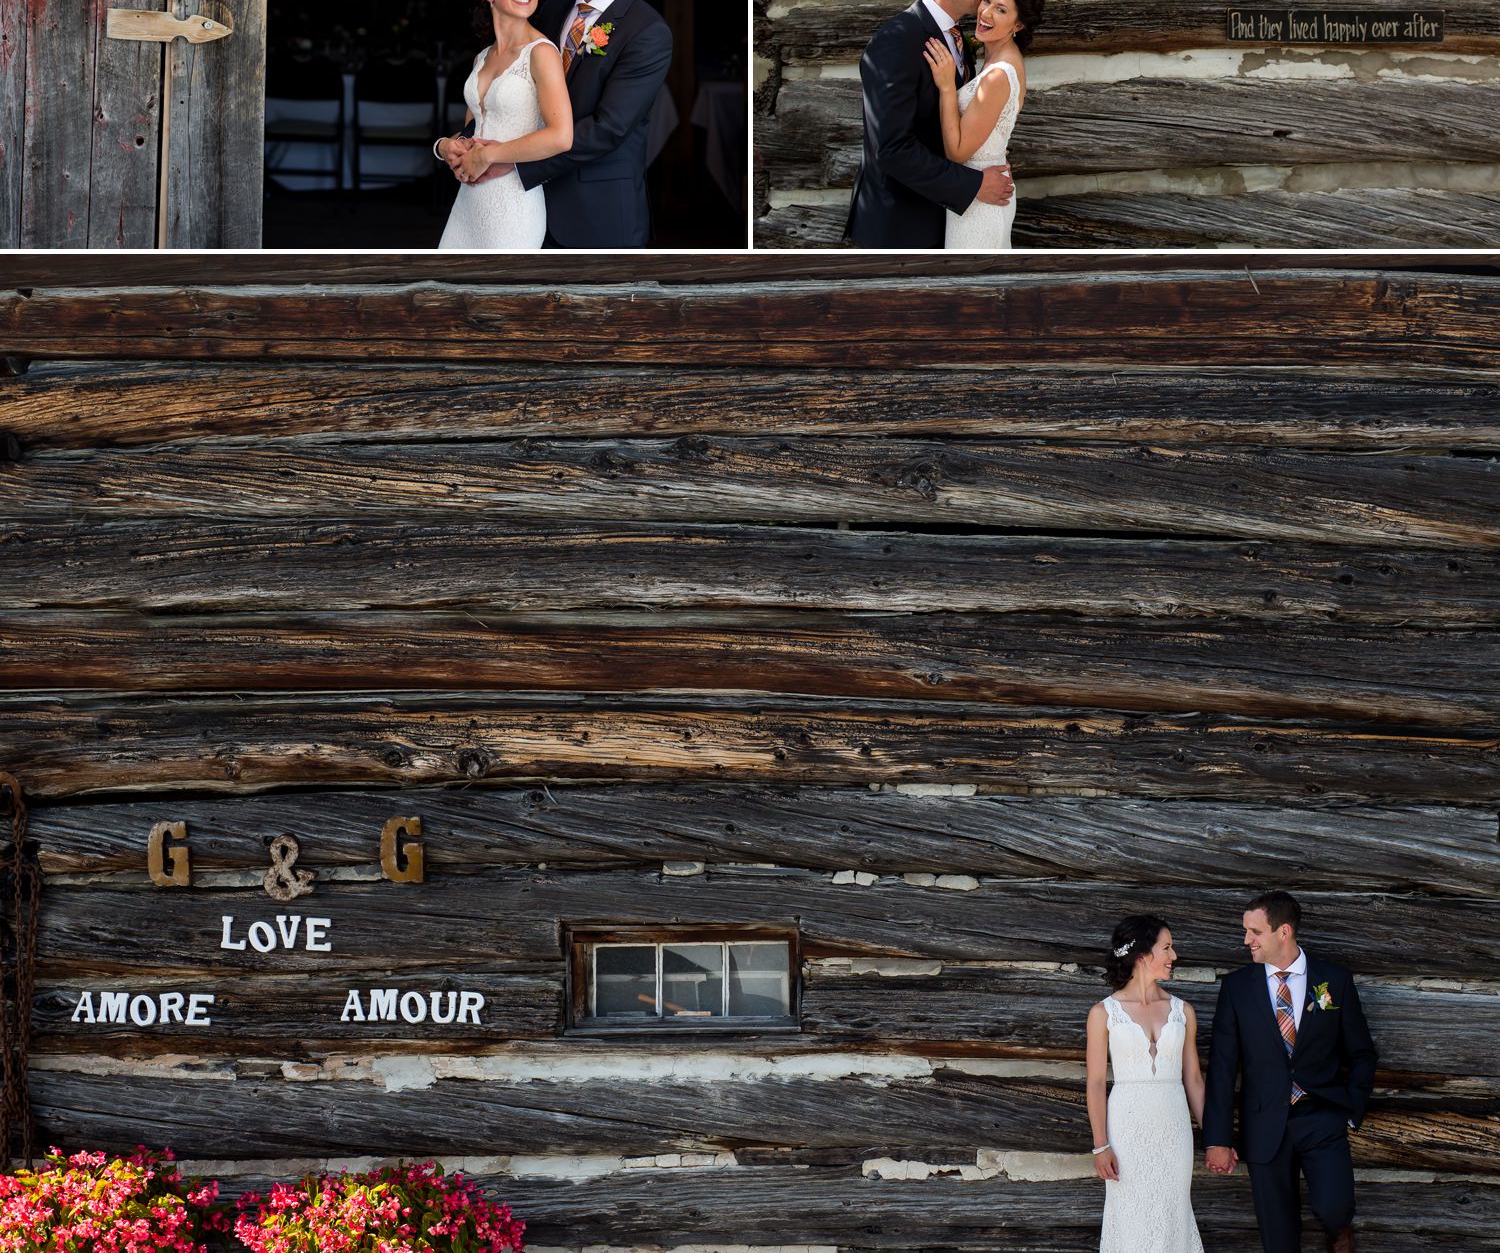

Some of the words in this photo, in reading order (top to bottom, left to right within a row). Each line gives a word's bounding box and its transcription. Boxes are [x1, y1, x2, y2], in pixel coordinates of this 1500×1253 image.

[1231, 12, 1254, 39] And
[1259, 14, 1283, 41] they
[1289, 11, 1318, 39] lived
[1323, 14, 1368, 41] happily
[1372, 19, 1400, 37] ever
[1403, 13, 1440, 38] after
[147, 820, 192, 887] G
[263, 834, 316, 901] &
[379, 816, 425, 883] G
[220, 915, 332, 953] LOVE
[71, 991, 215, 1027] AMORE
[340, 989, 486, 1025] AMOUR
